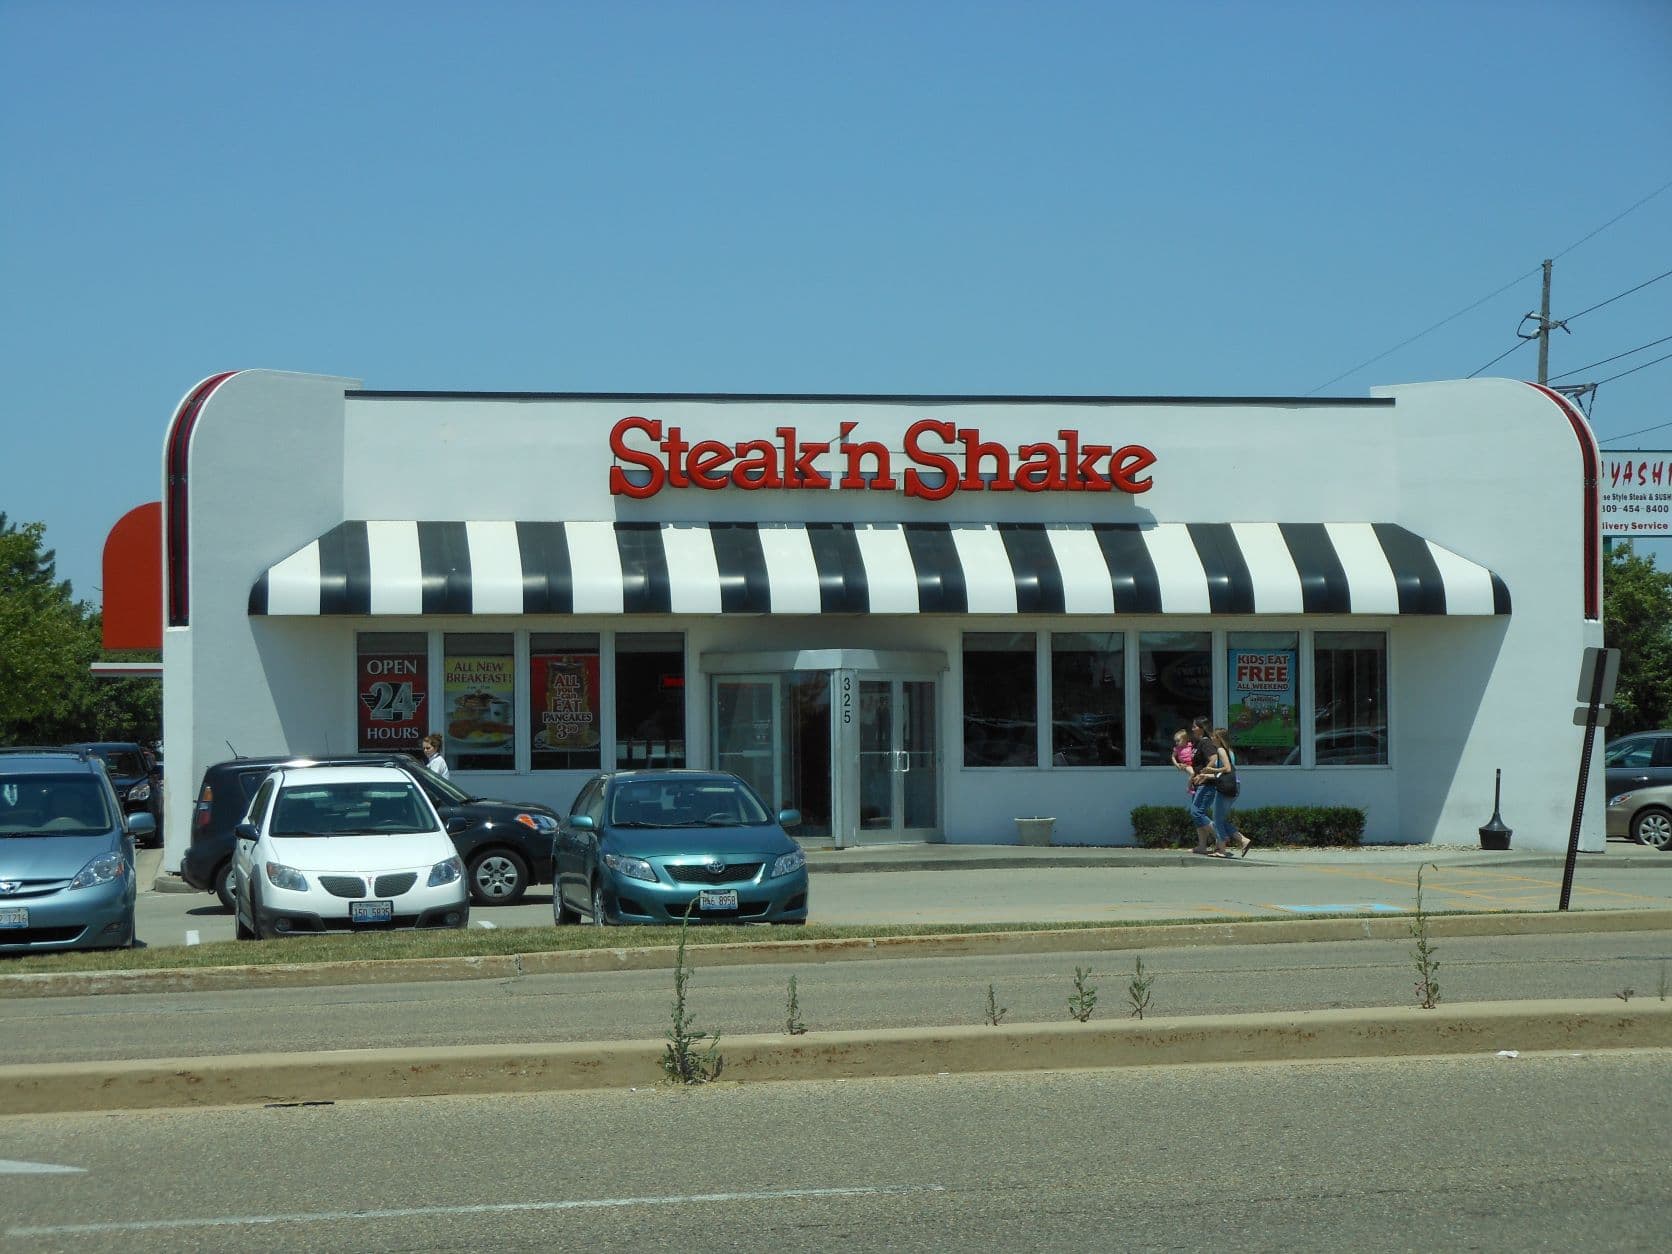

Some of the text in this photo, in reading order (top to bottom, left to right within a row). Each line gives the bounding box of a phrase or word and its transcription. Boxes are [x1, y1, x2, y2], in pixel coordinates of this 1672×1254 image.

[903, 418, 1157, 501] Shake
[1612, 493, 1628, 502] Style
[1630, 493, 1647, 501] Steak
[1631, 521, 1669, 530] Service
[1238, 655, 1288, 664] KIDS EAT
[367, 659, 417, 675] OPEN
[454, 661, 504, 672] ALL NEW
[446, 673, 512, 683] BREAKFAST!
[1238, 666, 1288, 682] FREE
[554, 674, 579, 687] ALL
[369, 681, 417, 720] 24
[553, 699, 582, 713] EAT
[543, 712, 593, 723] PANCAKES
[367, 728, 419, 740] HOURS
